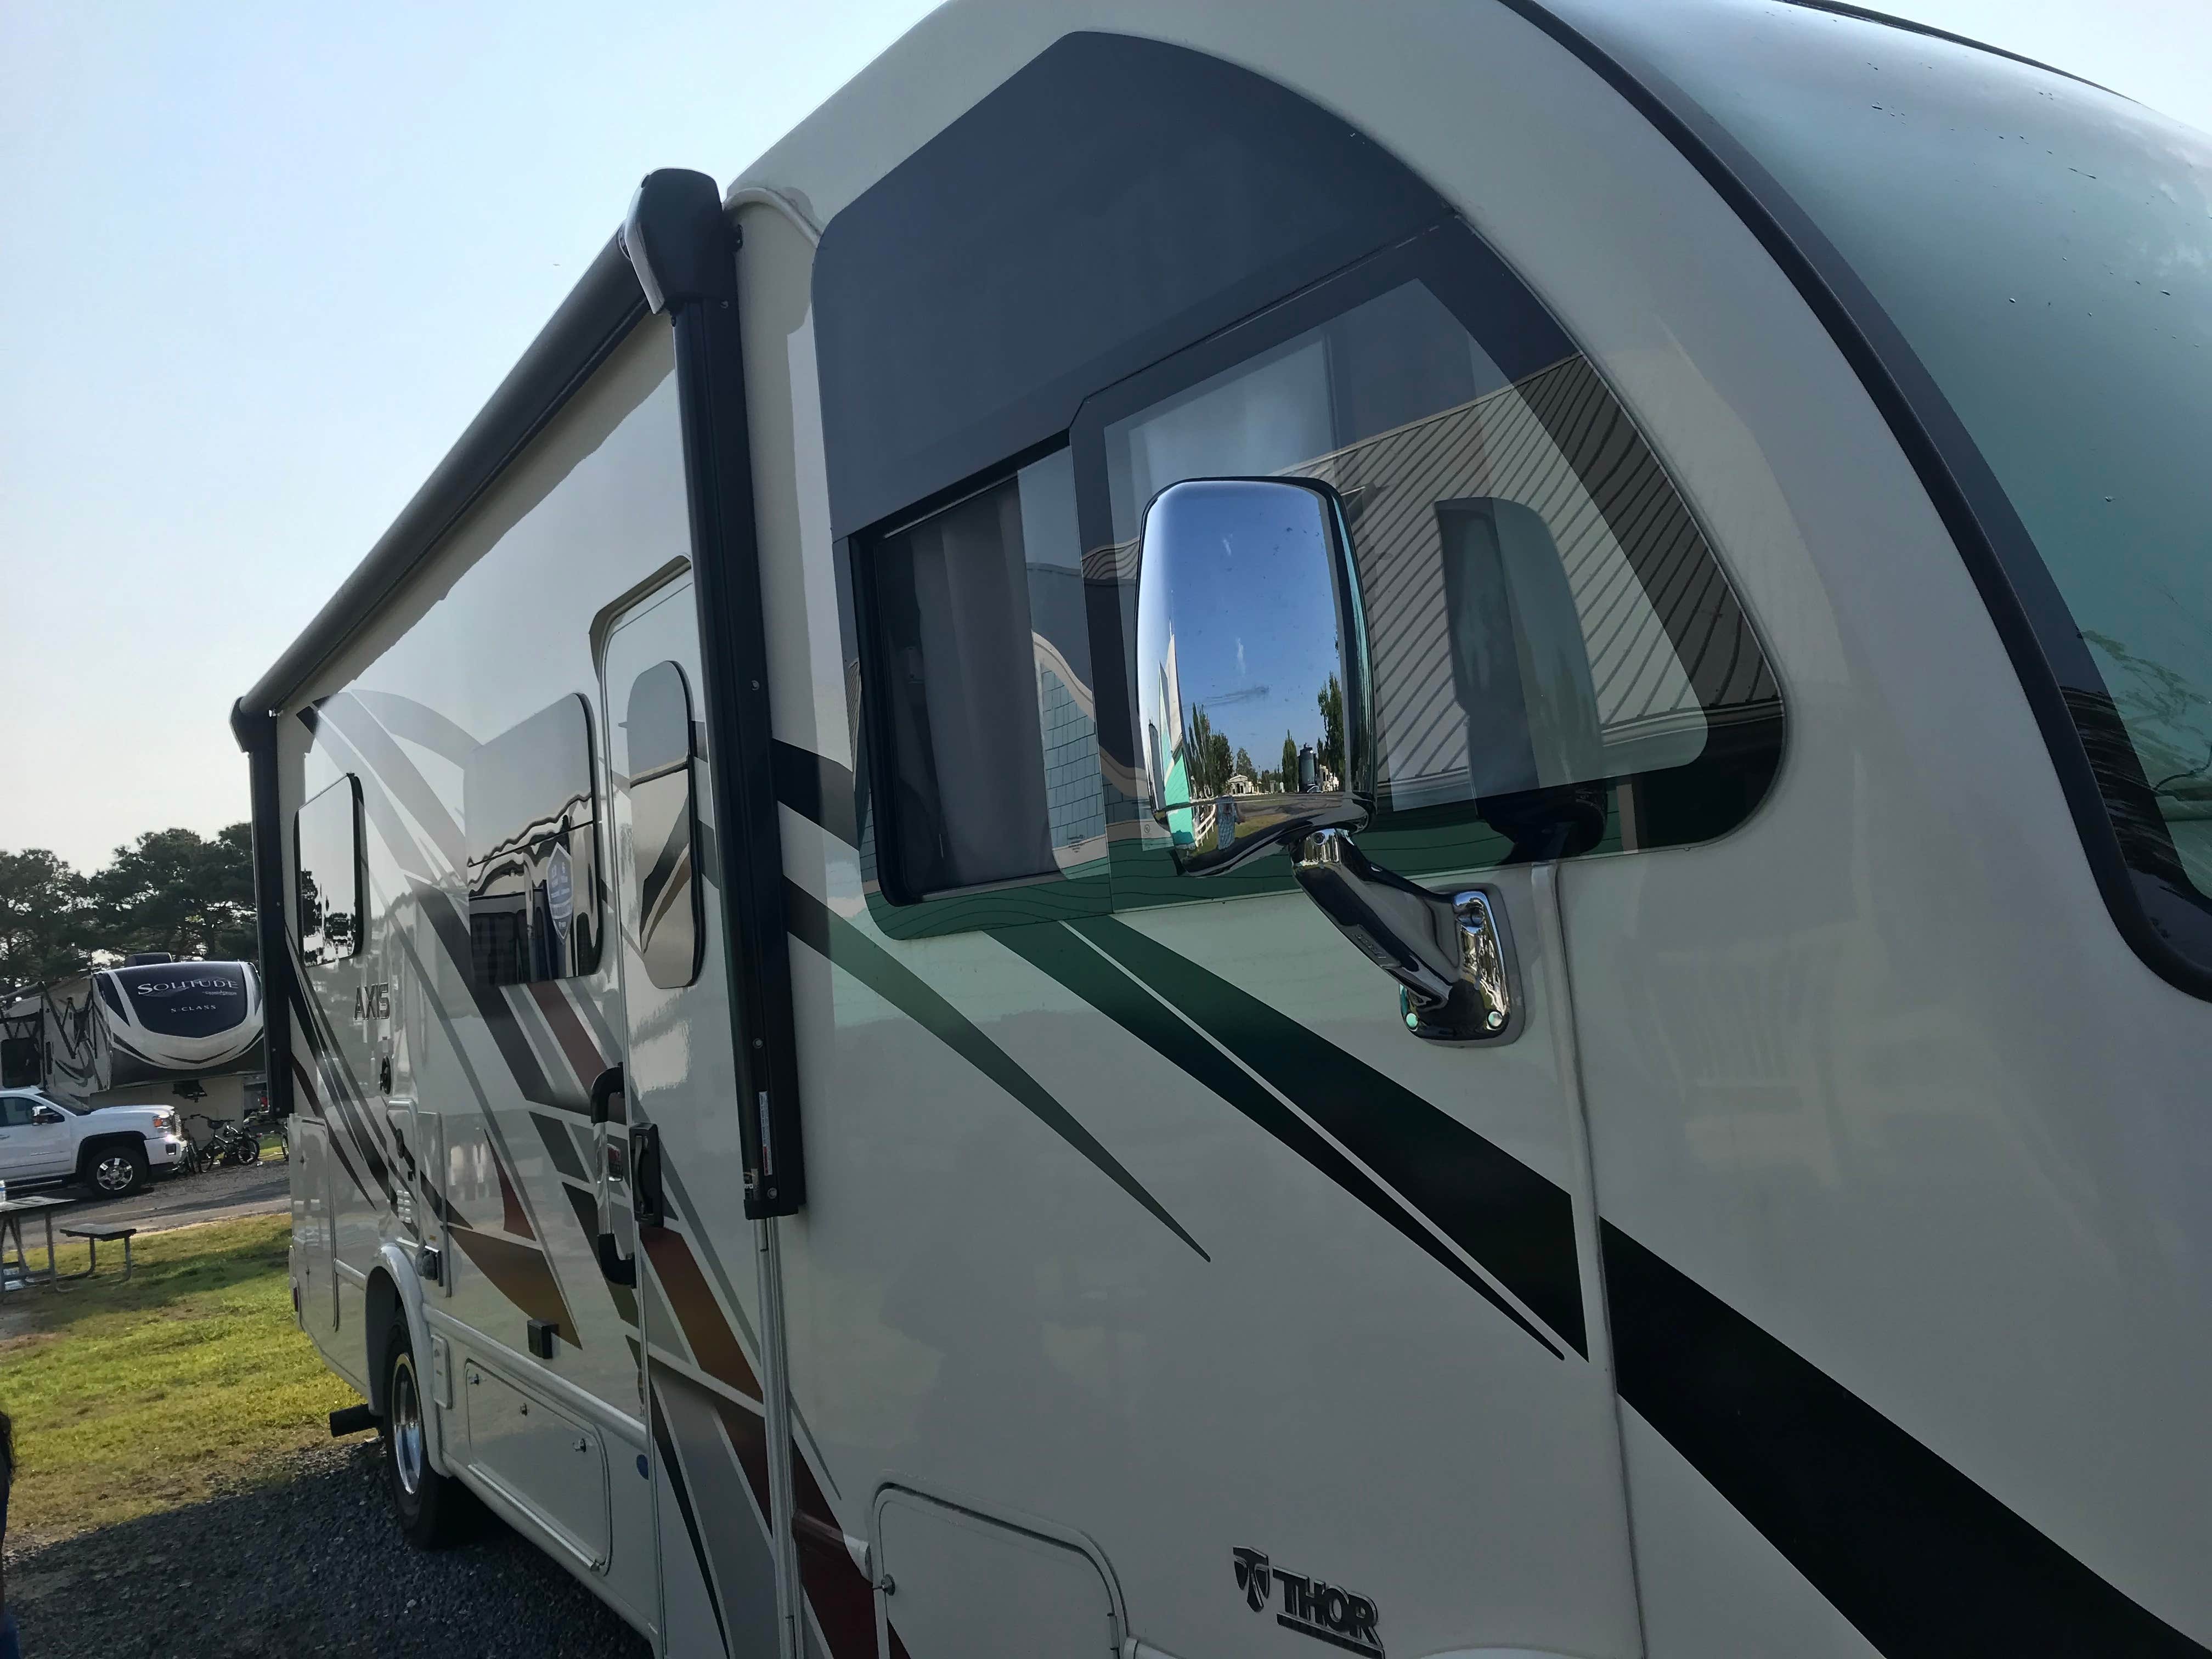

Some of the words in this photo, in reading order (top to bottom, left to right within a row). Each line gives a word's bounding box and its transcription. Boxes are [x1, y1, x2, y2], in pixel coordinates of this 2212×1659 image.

[138, 980, 239, 995] SOLITUDE
[354, 983, 390, 1020] AXIS
[1273, 1566, 1383, 1648] THOR
